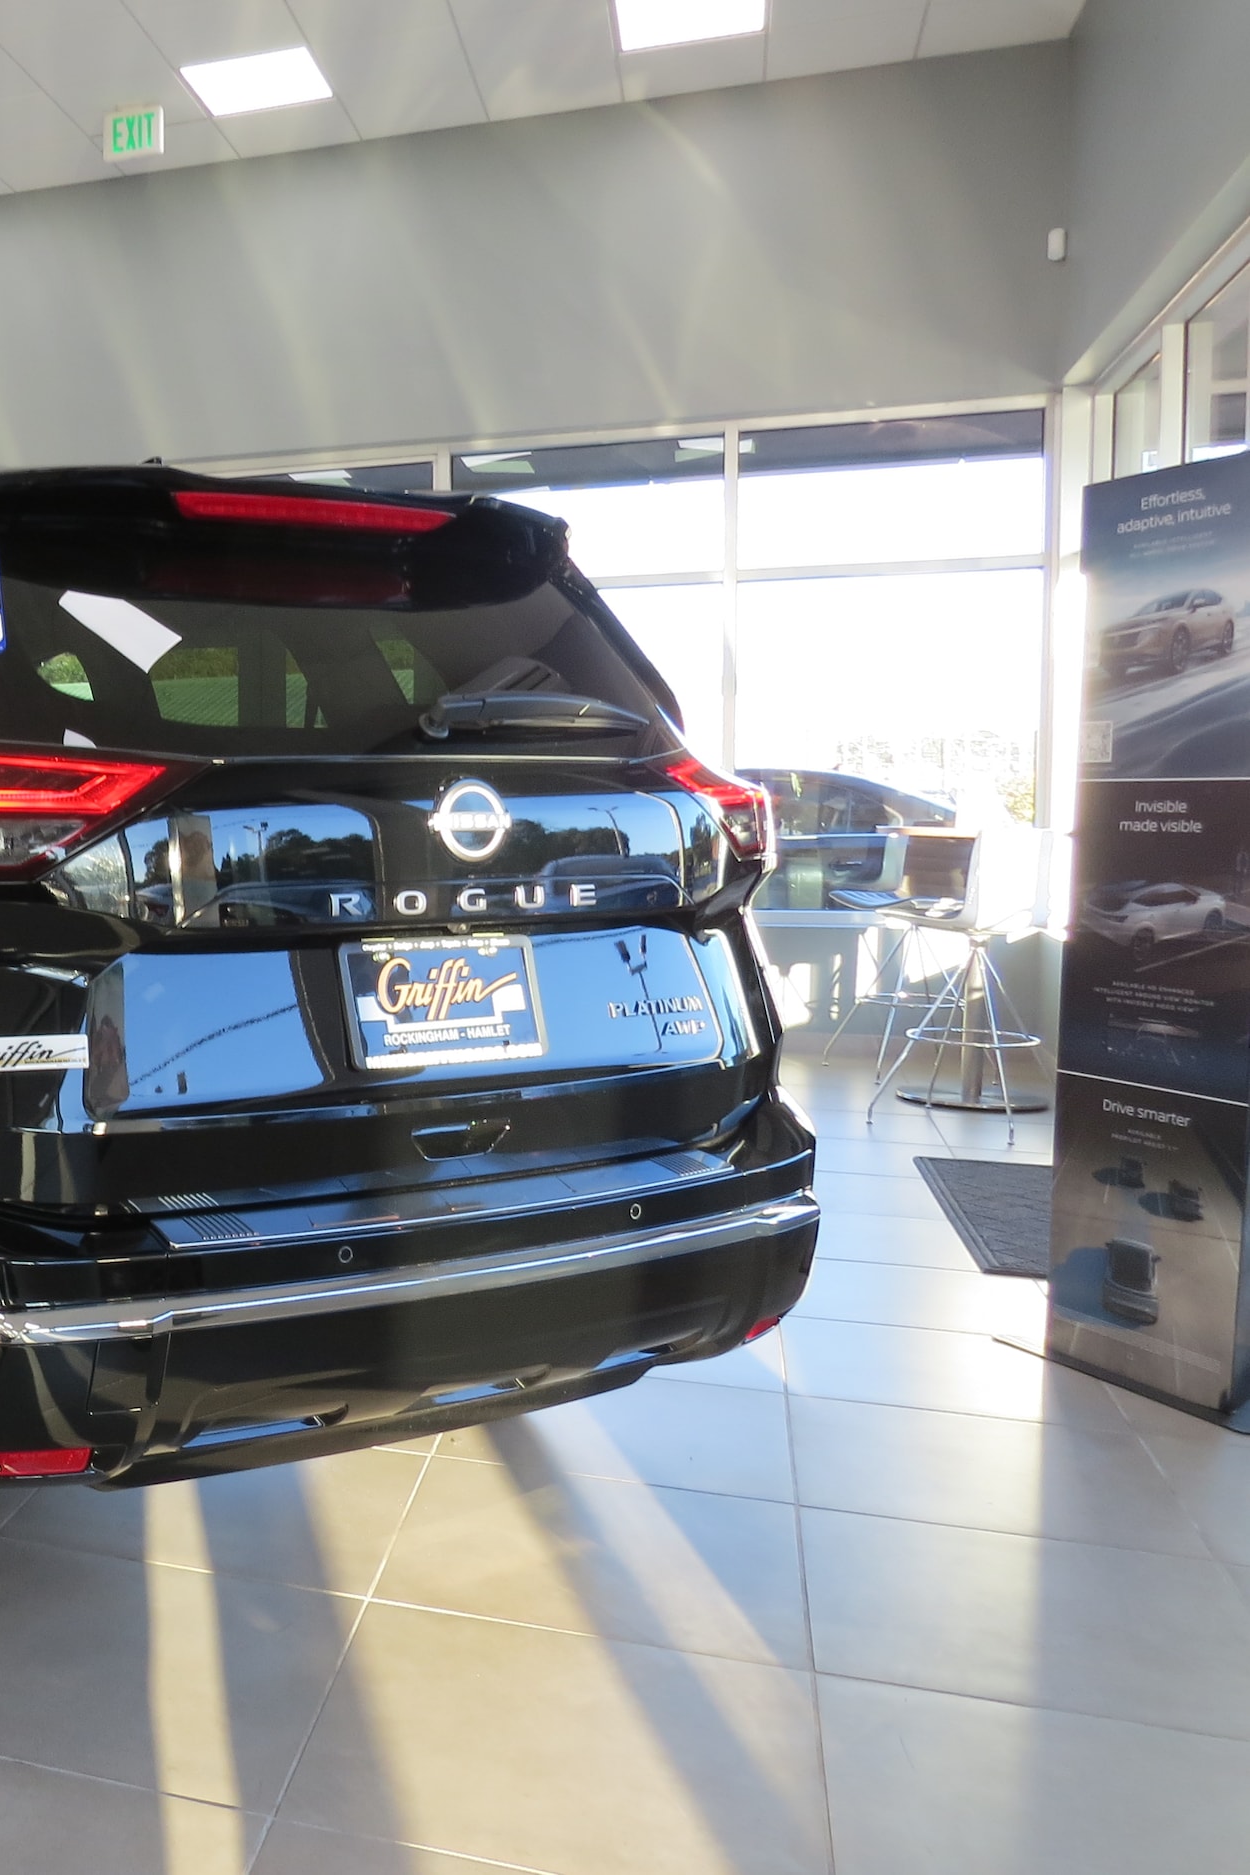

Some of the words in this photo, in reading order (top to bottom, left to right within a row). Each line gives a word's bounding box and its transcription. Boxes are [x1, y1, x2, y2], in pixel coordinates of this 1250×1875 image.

[111, 112, 155, 153] EXIT
[1140, 488, 1206, 511] Effortless,
[1116, 513, 1175, 534] adaptive,
[1177, 502, 1232, 523] intuitive
[1134, 800, 1188, 813] Invisible
[436, 813, 511, 829] ISSAN
[1119, 819, 1158, 832] made
[1159, 819, 1203, 833] visible
[328, 883, 598, 918] ROGUE
[376, 956, 519, 1021] Griffin
[607, 996, 703, 1019] PLATINUM
[382, 1029, 460, 1047] ROCKINGHAM
[466, 1024, 511, 1039] HAMLET
[1102, 1098, 1135, 1117] Drive
[1136, 1106, 1191, 1127] smarter
